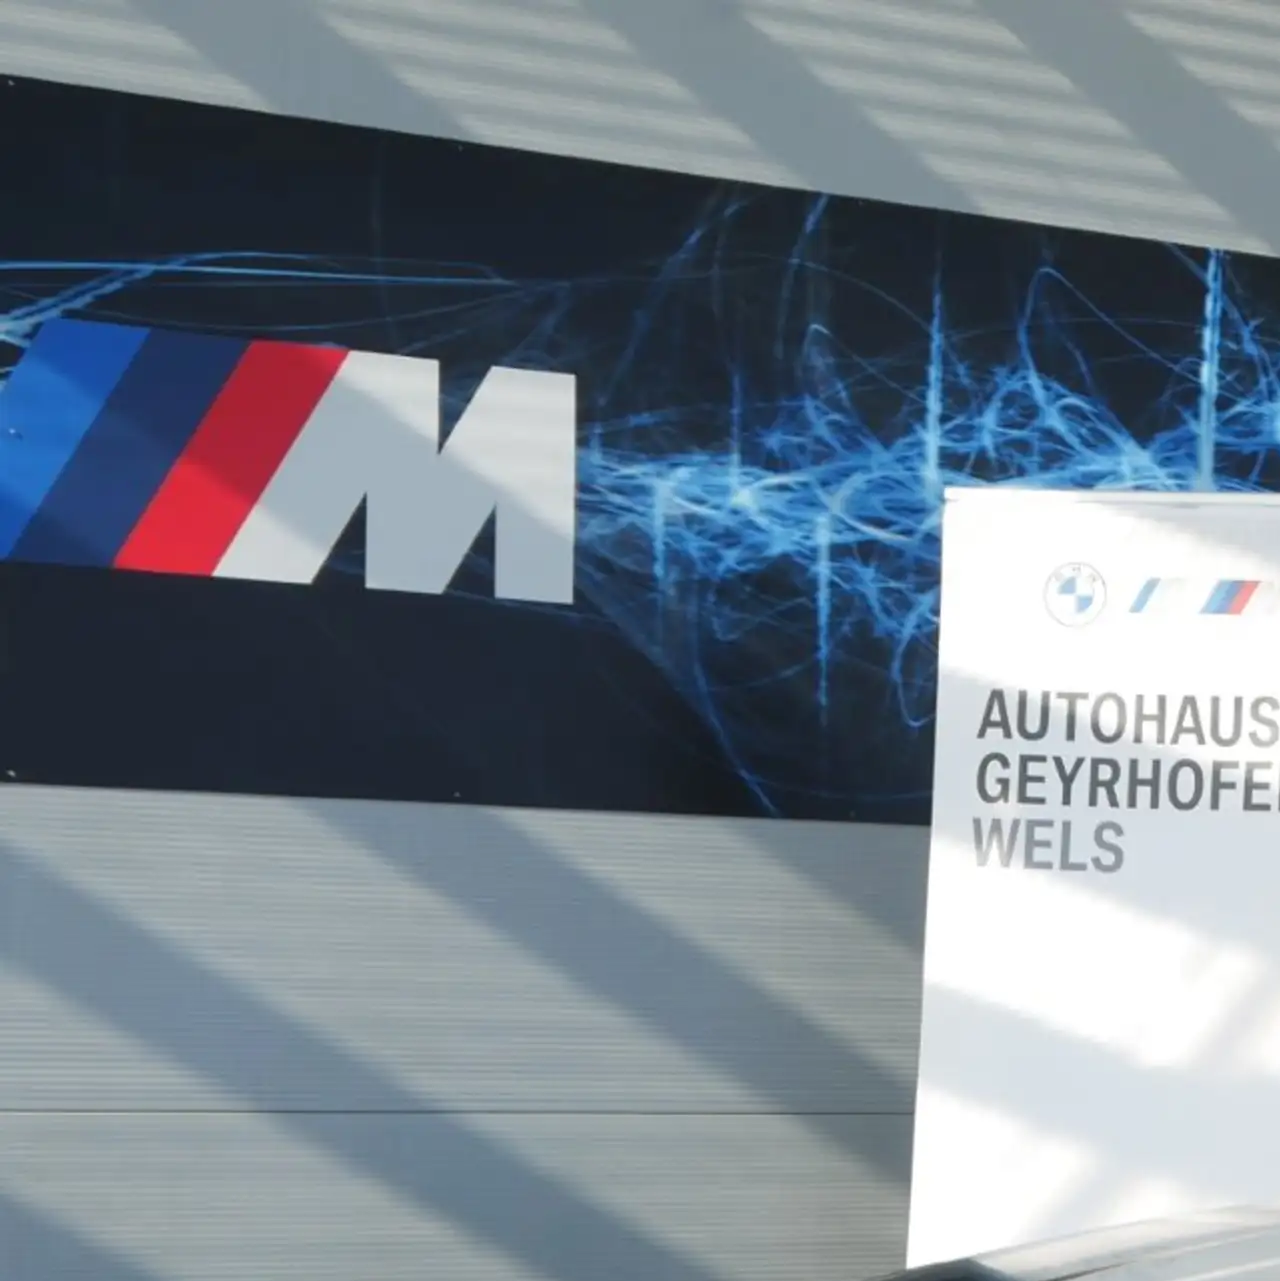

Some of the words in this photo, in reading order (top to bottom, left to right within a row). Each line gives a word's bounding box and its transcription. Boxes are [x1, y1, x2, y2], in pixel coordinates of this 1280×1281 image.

[212, 350, 577, 604] M
[976, 688, 1280, 748] AUTOHAUS
[973, 817, 1125, 873] WELS
